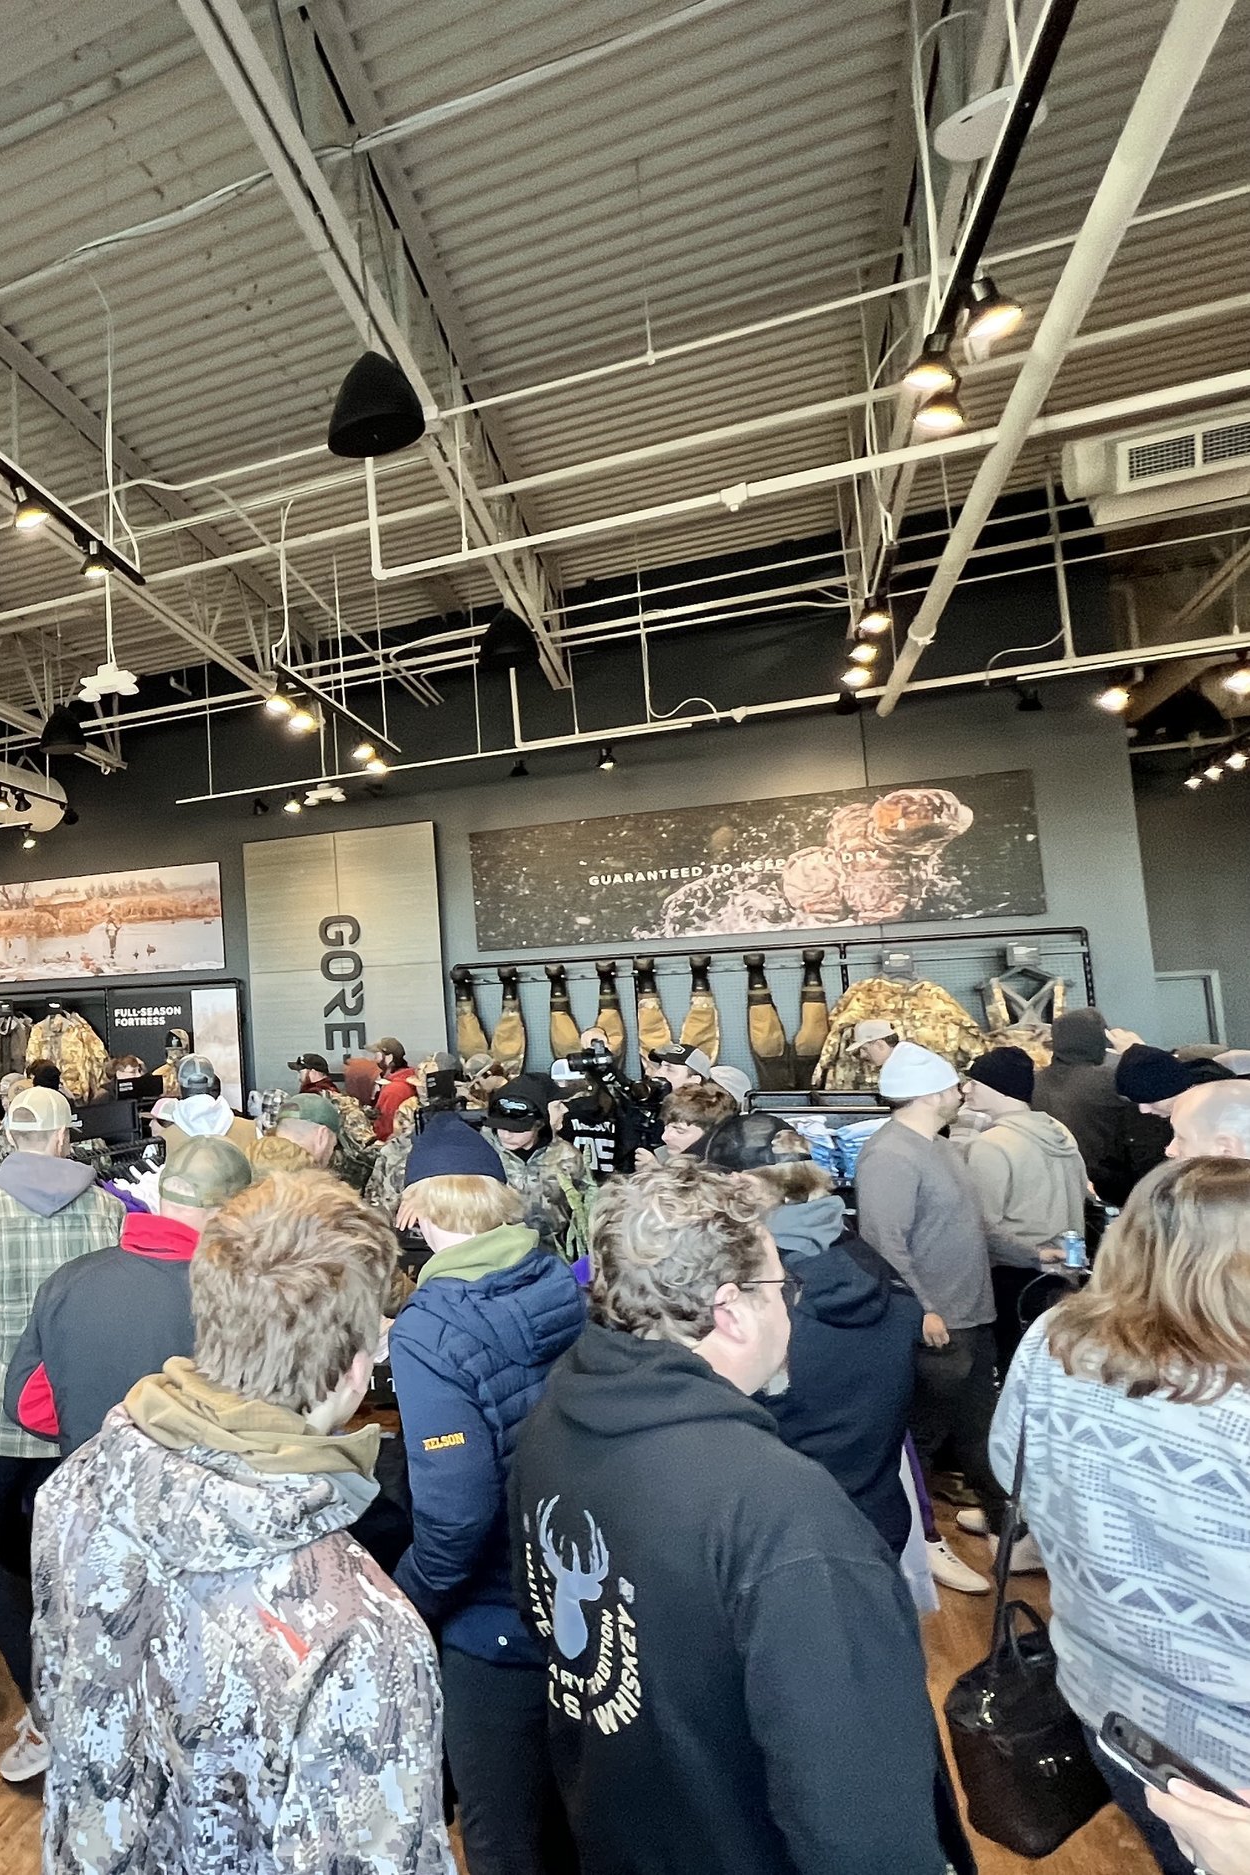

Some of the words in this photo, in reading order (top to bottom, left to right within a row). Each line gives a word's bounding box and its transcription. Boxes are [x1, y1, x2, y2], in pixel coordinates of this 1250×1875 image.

[588, 866, 703, 886] GUARANTEED
[709, 864, 734, 876] TO
[740, 858, 786, 873] KEEP
[841, 849, 880, 864] DRY
[114, 1006, 182, 1018] FULL-SEASON
[115, 1016, 166, 1027] FORTRESS
[592, 1603, 641, 1735] WHISKEY
